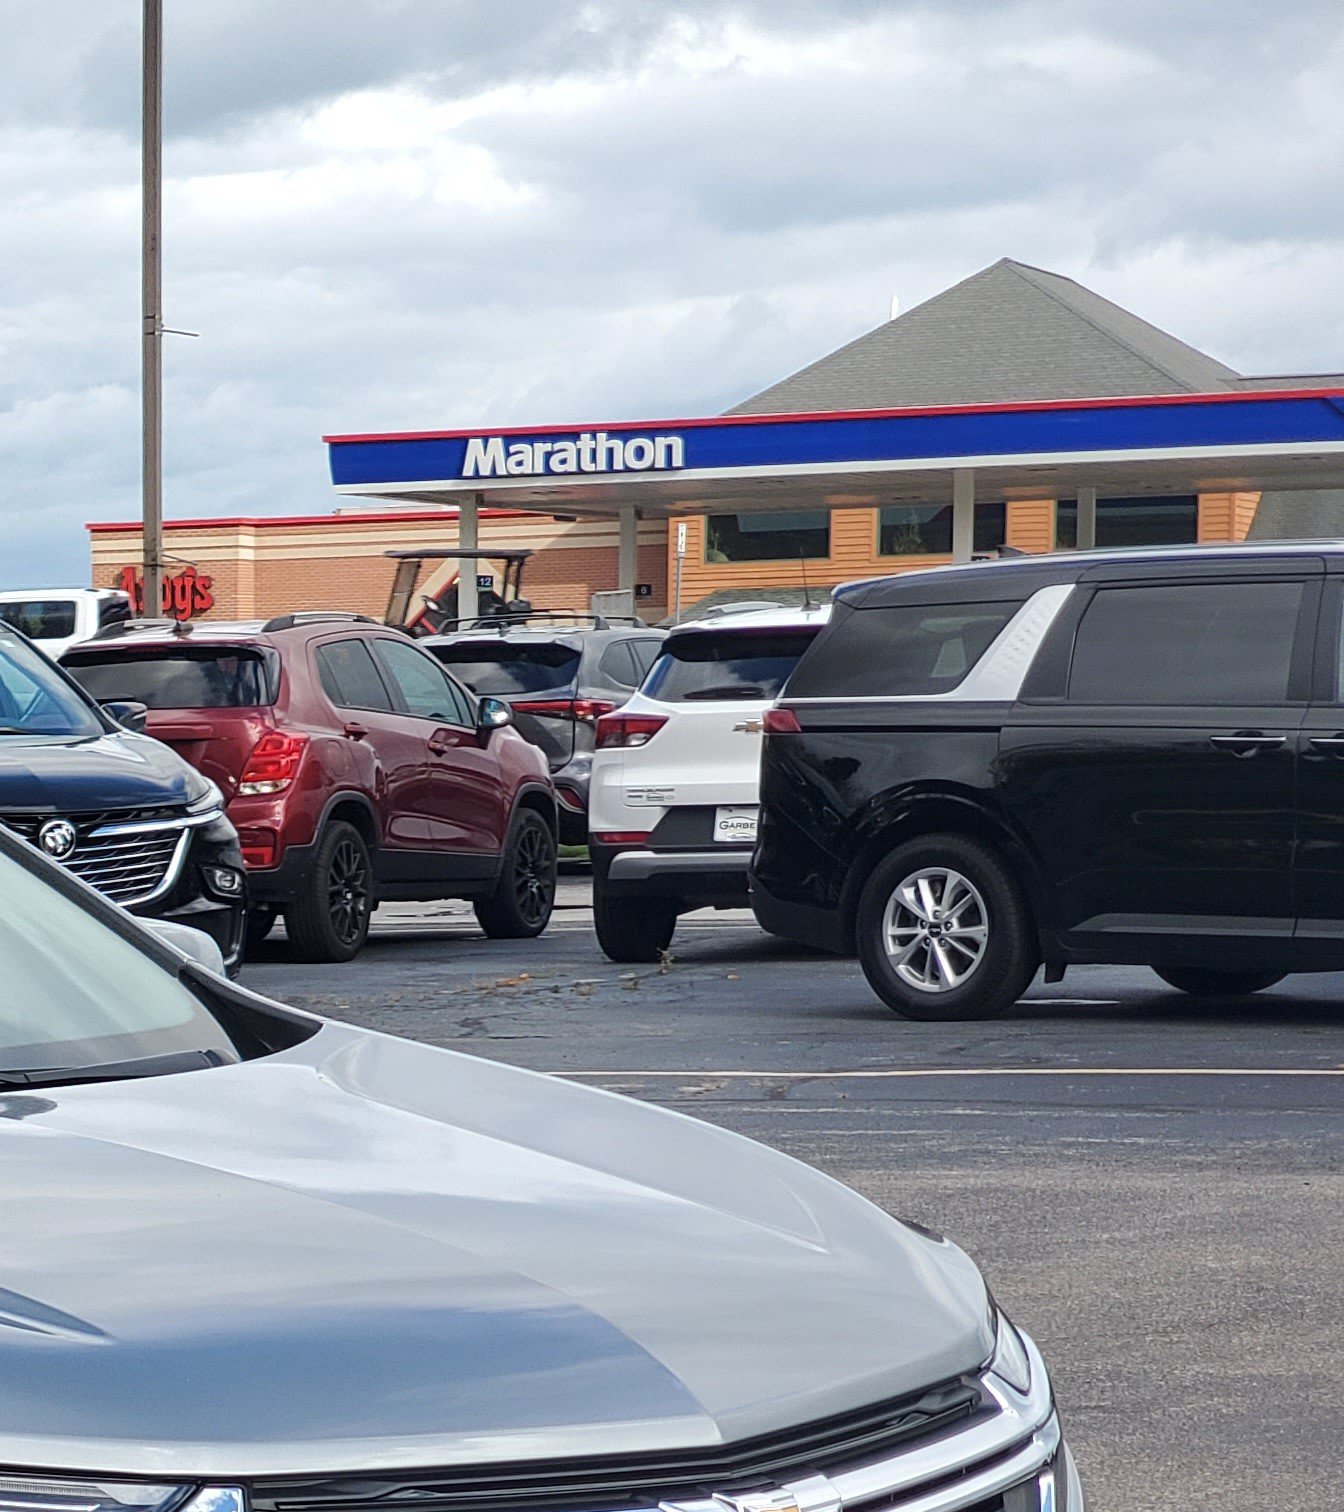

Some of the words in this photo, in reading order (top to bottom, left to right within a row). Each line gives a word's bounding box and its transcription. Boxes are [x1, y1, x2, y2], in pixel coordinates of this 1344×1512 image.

[462, 433, 683, 477] Marathon
[120, 566, 214, 621] Ay's
[479, 576, 492, 586] 12
